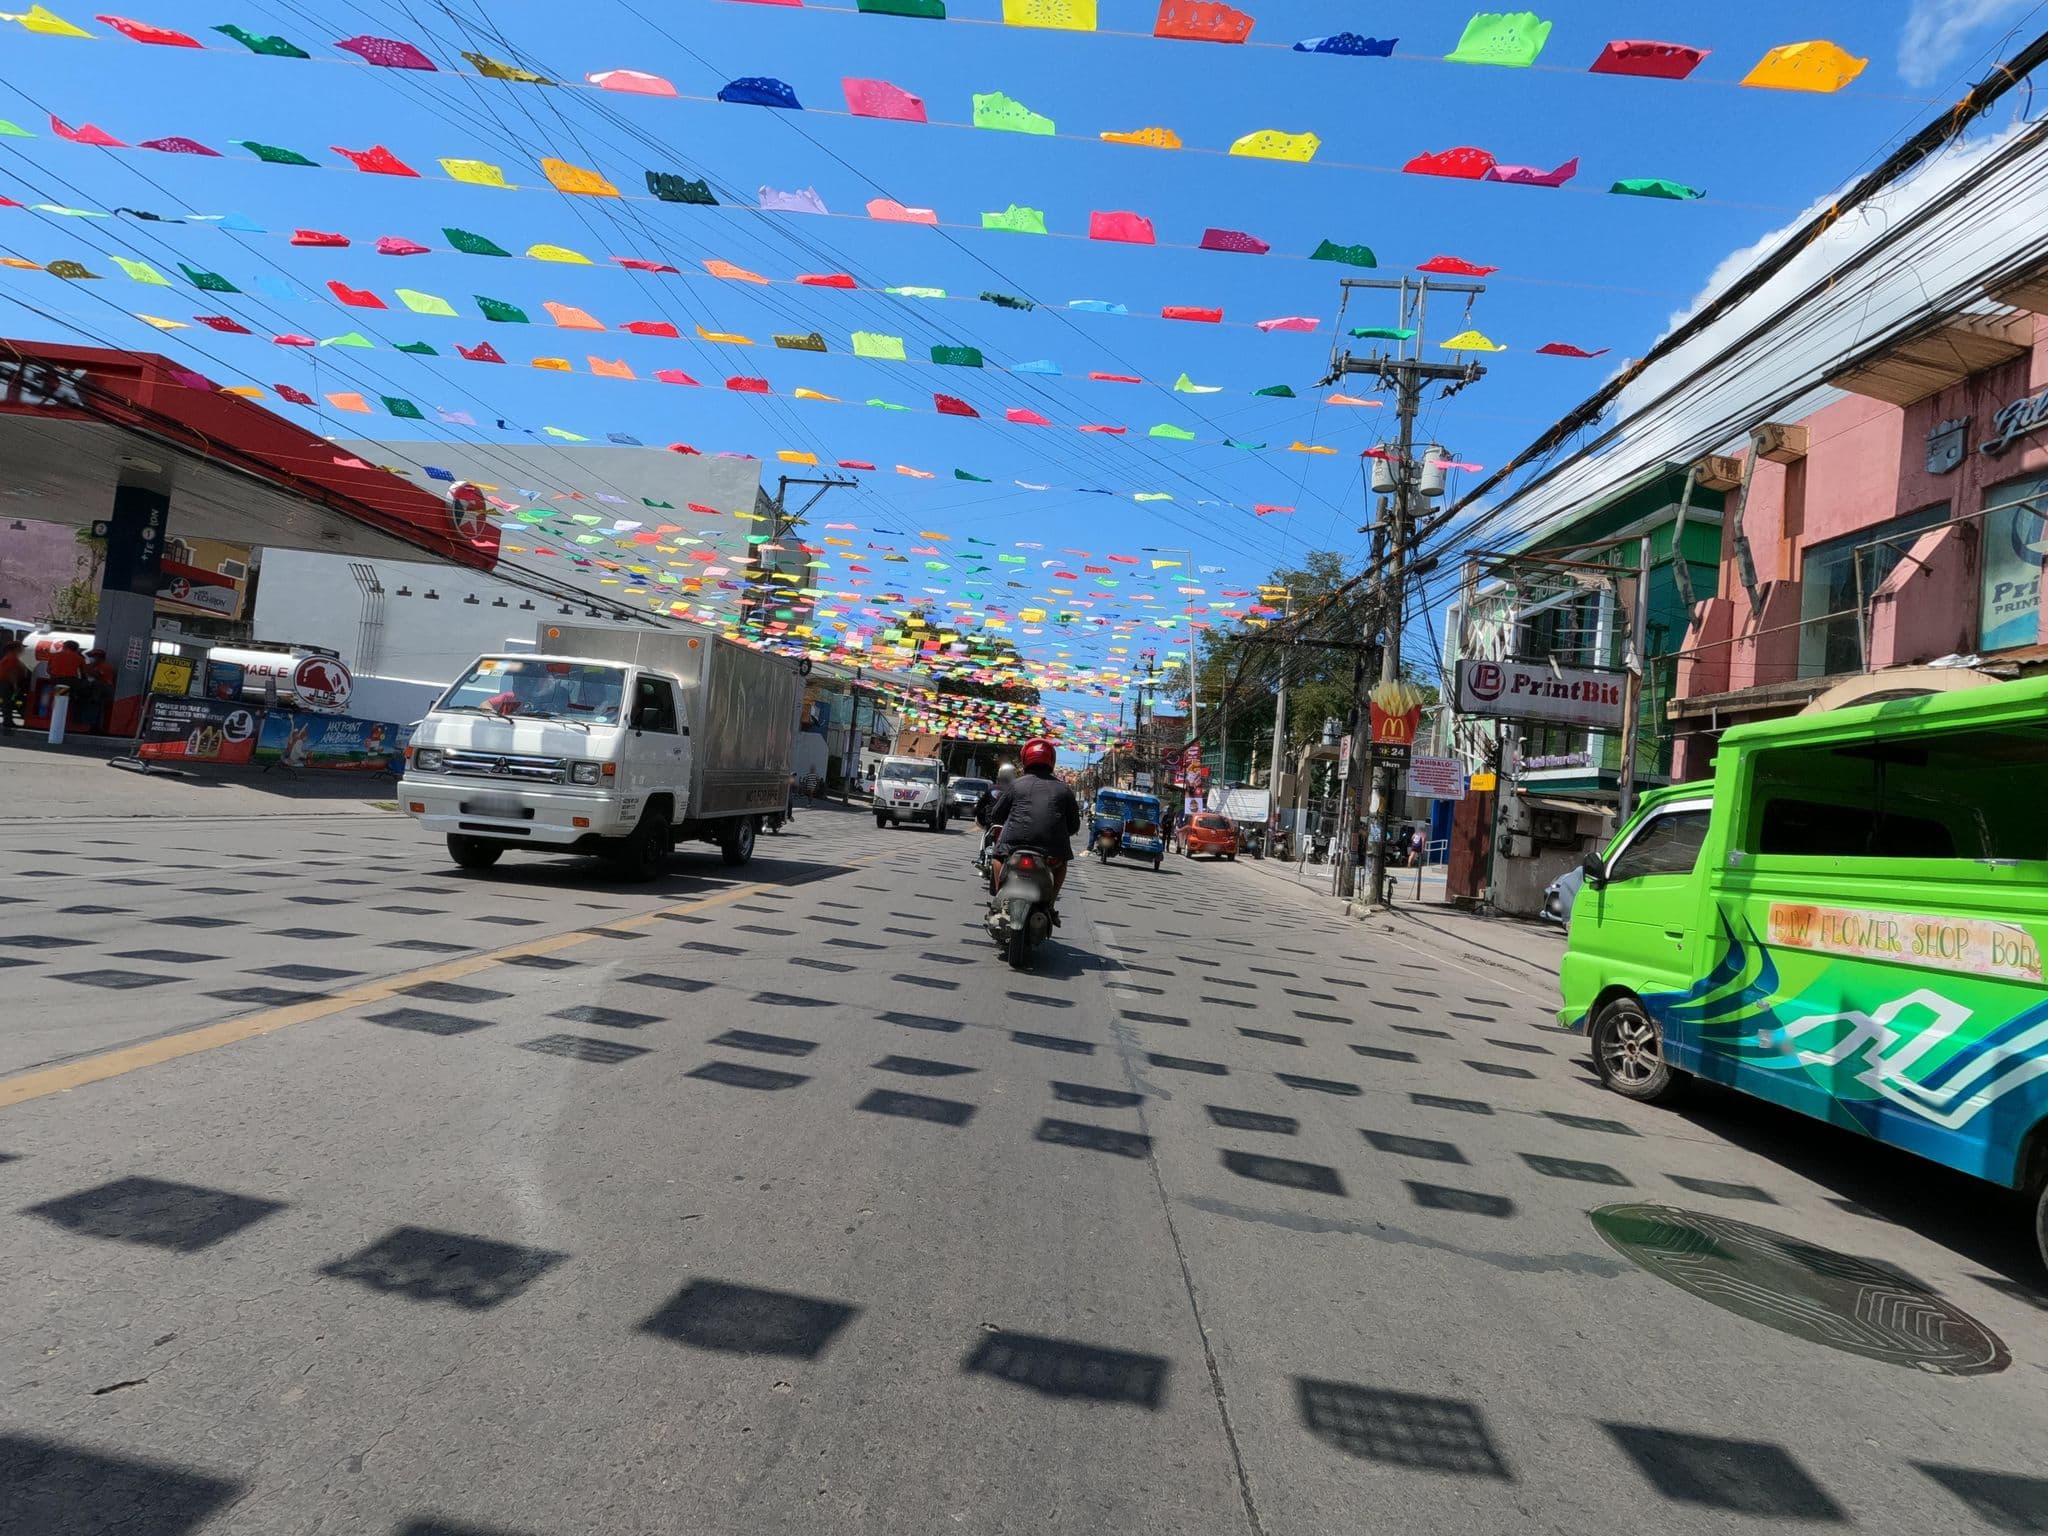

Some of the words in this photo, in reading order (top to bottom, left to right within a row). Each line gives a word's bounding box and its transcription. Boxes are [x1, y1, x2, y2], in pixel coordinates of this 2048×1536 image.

[1510, 673, 1619, 705] PrintBit
[1381, 760, 1401, 769] 1km
[1819, 911, 1902, 953] FLOWER
[1911, 923, 1970, 961] SHOP
